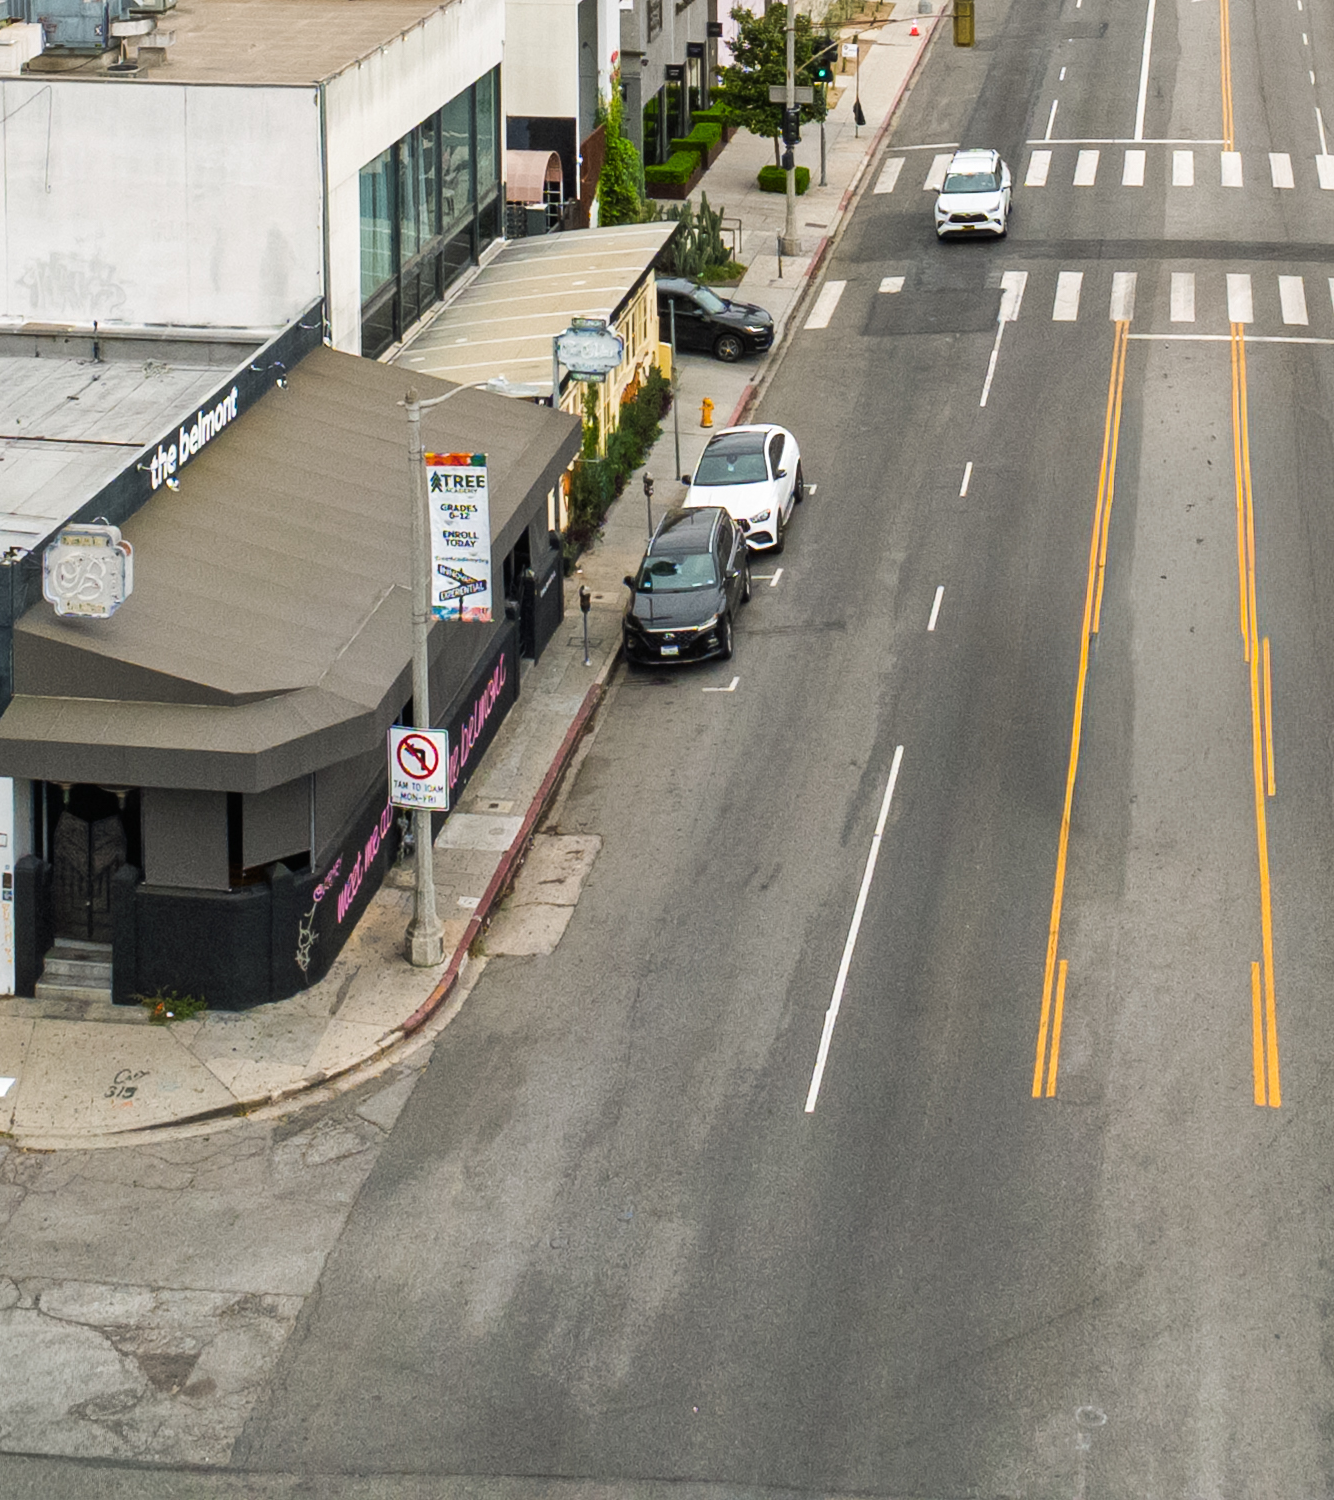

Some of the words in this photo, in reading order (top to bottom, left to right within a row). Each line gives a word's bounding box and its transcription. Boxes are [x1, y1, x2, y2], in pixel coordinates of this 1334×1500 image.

[151, 444, 177, 490] the
[179, 385, 238, 466] belmont
[441, 474, 485, 489] TREE
[440, 503, 478, 513] GRADES
[442, 530, 479, 540] ENROLL
[445, 538, 477, 548] TODAY
[412, 782, 422, 792] TO
